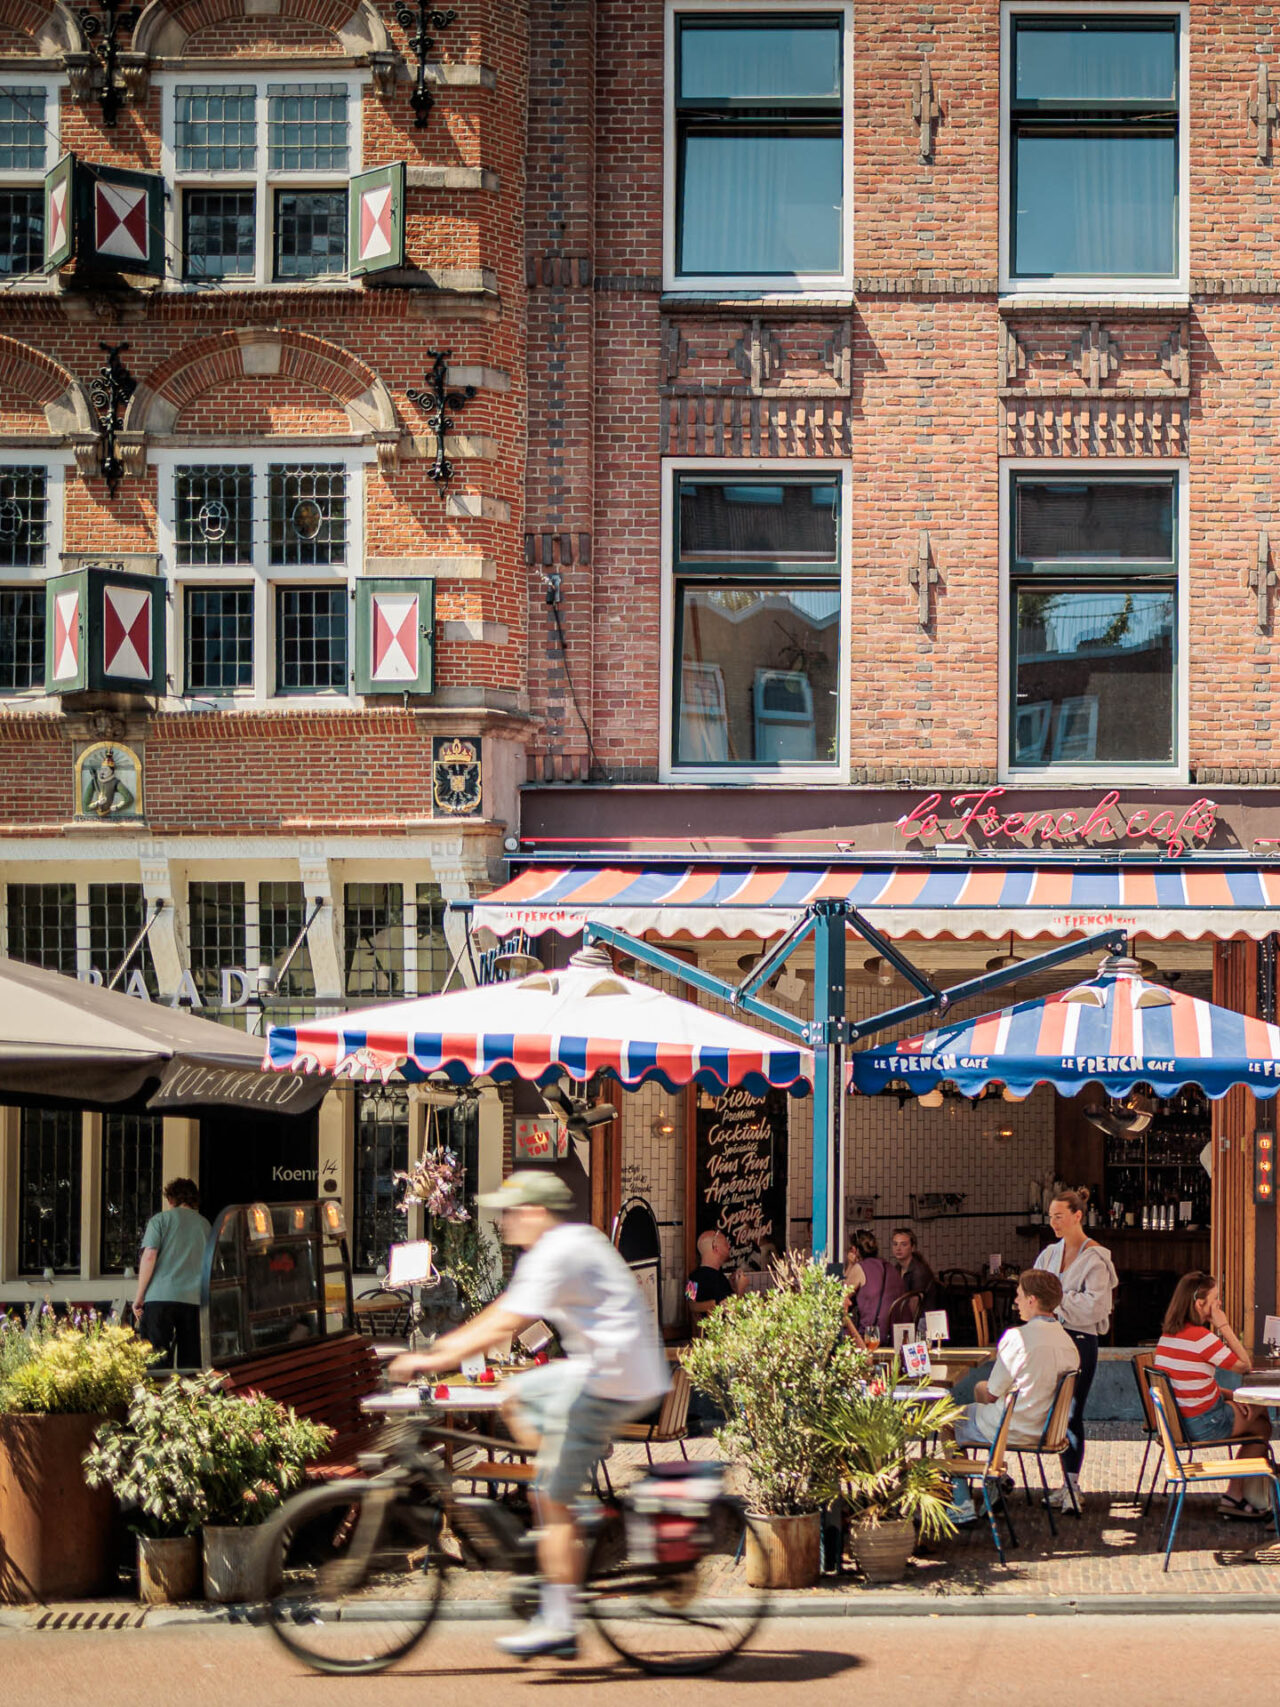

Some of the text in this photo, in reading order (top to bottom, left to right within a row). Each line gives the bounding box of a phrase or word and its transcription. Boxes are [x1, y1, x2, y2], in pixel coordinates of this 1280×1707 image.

[895, 787, 1221, 858] le French café
[1064, 913, 1114, 928] FRENCH
[874, 1059, 887, 1069] LE
[888, 1053, 958, 1073] FRENCH
[1061, 1058, 1074, 1068] LE
[1076, 1055, 1144, 1074] FRENCH
[1248, 1062, 1261, 1073] LE
[158, 1064, 304, 1105] KOENRAAD
[708, 1116, 771, 1146] Cocktails
[272, 1166, 319, 1181] Koenr
[322, 1159, 338, 1175] 14
[707, 1151, 771, 1178] Vins Fins
[704, 1170, 770, 1203] Apéritifs
[717, 1202, 764, 1233] Spritz
